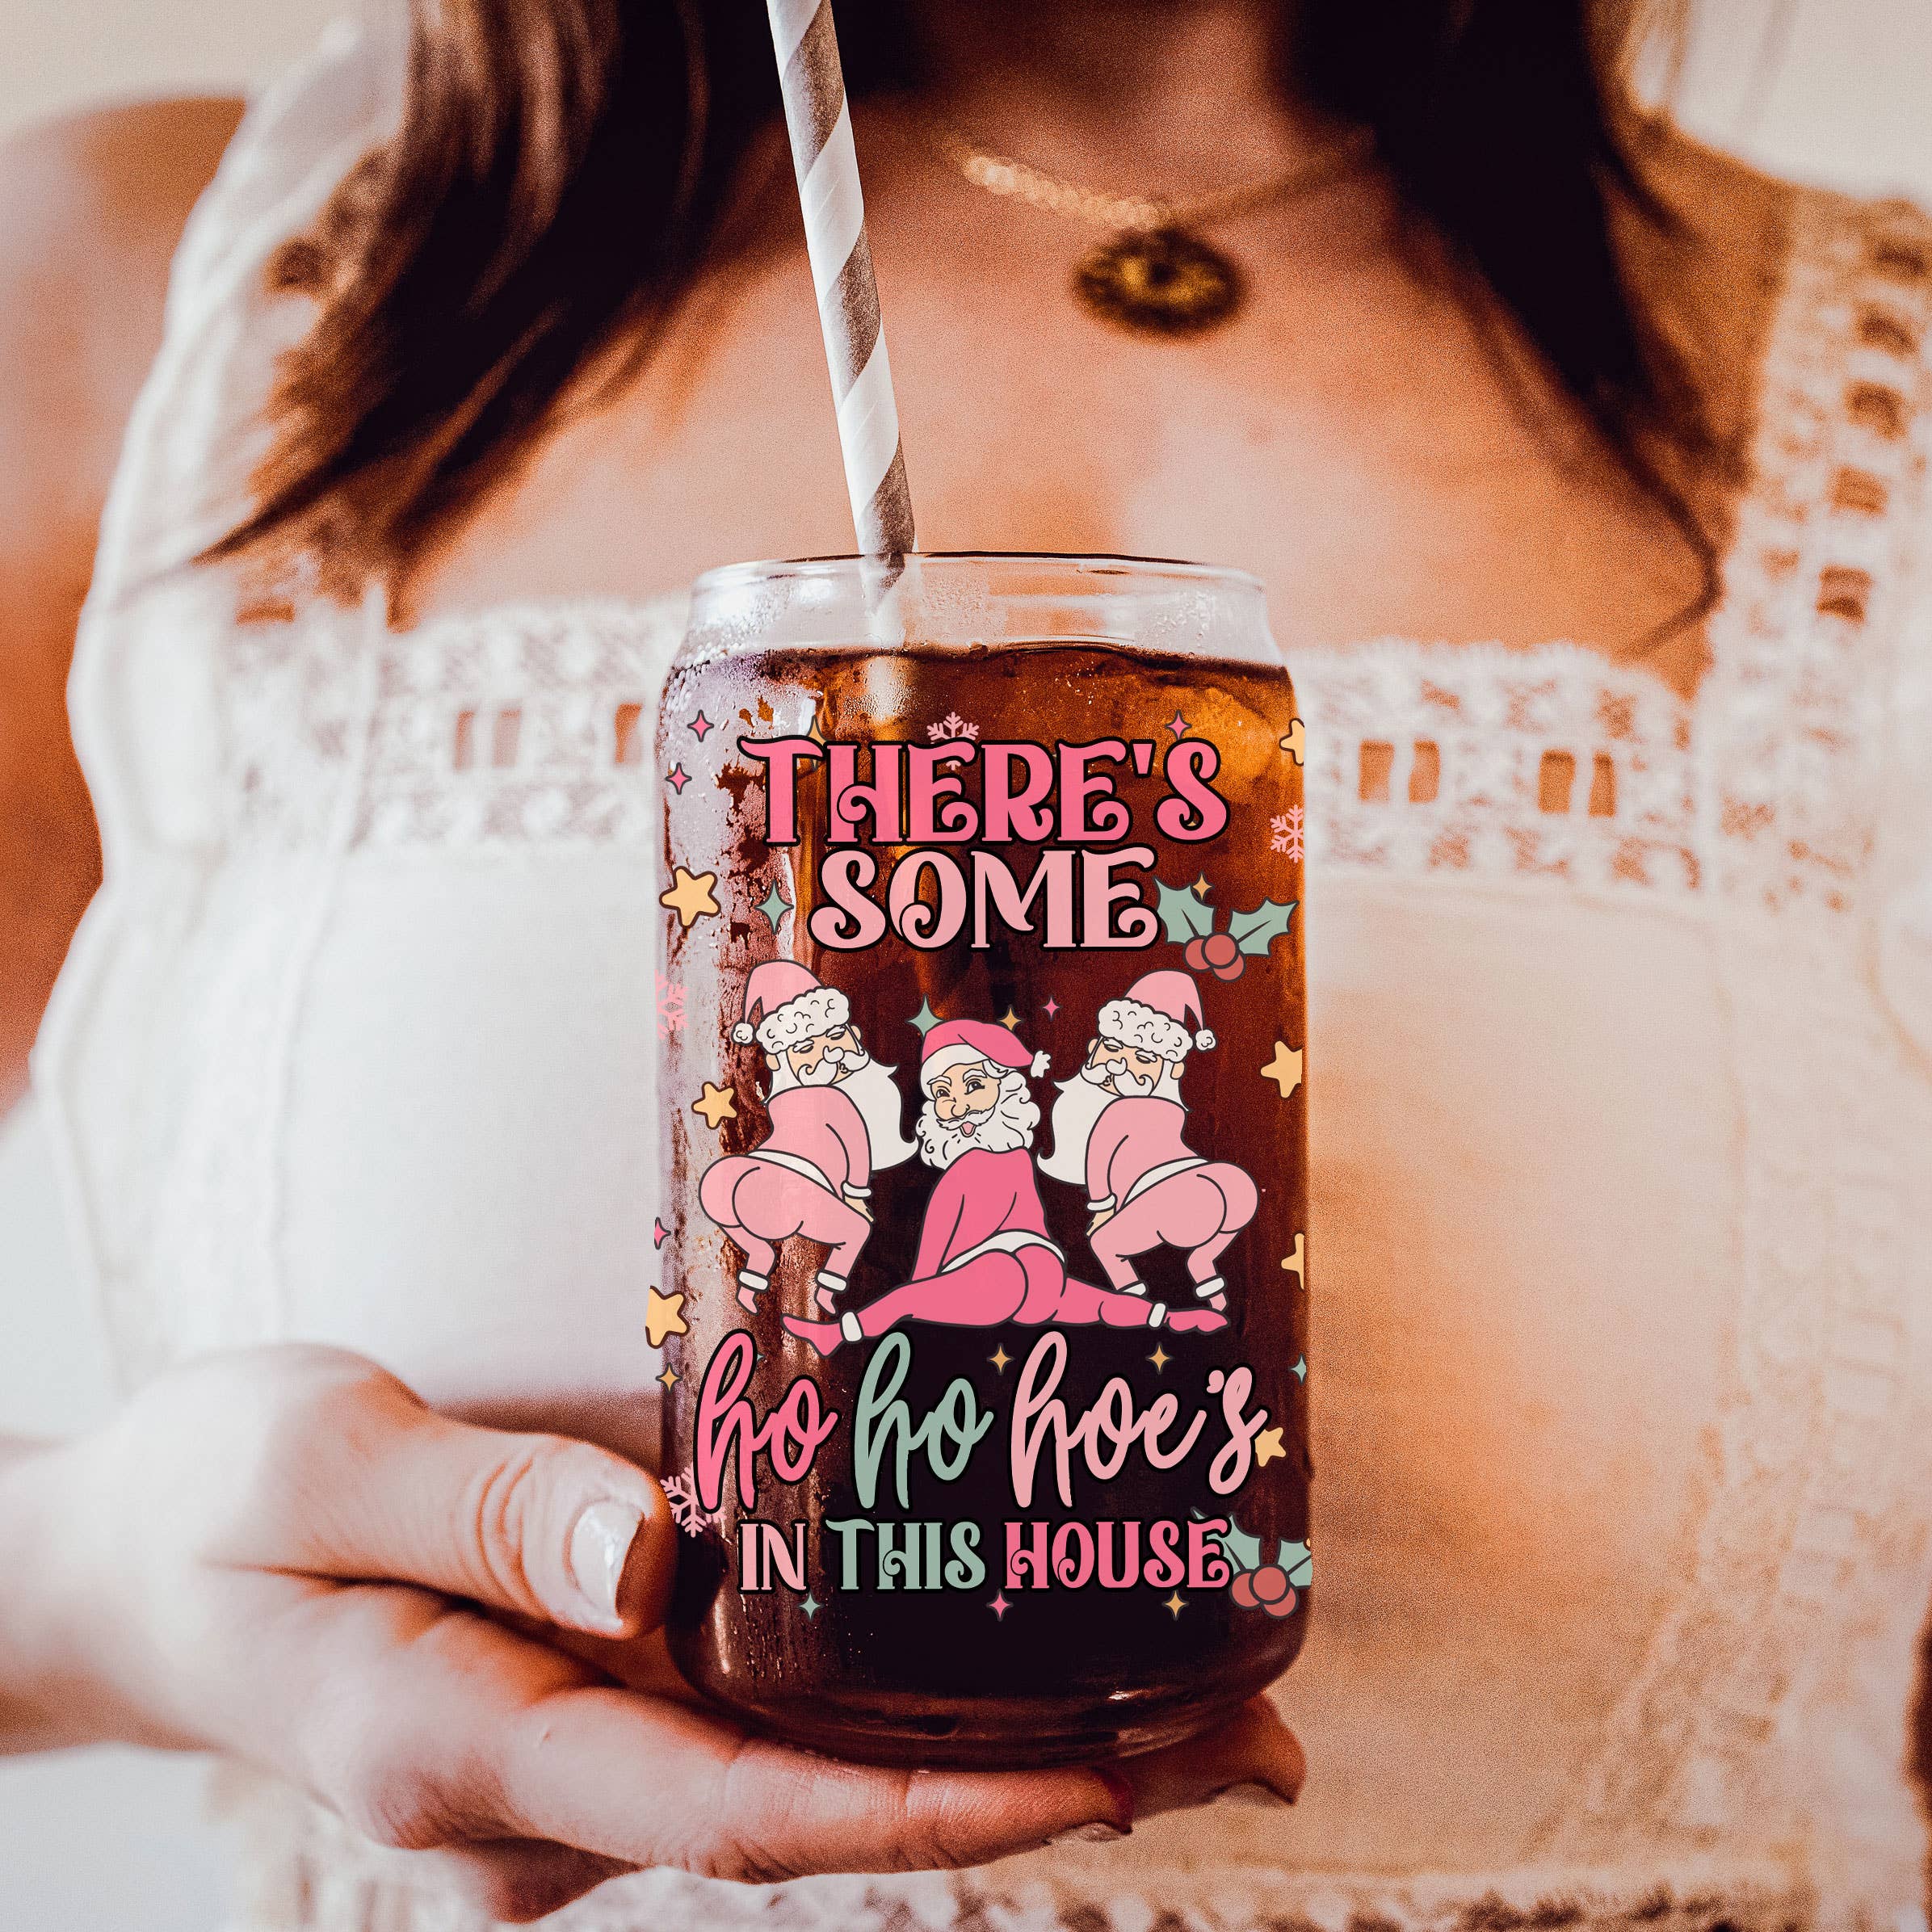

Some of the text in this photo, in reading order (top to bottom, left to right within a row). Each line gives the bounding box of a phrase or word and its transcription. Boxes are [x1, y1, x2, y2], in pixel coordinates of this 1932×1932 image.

[736, 733, 1230, 846] THERE'S
[807, 843, 1163, 952] SOME
[693, 1328, 1269, 1514] ho ho hoe's
[737, 1516, 1233, 1593] IN THIS HOUSE
